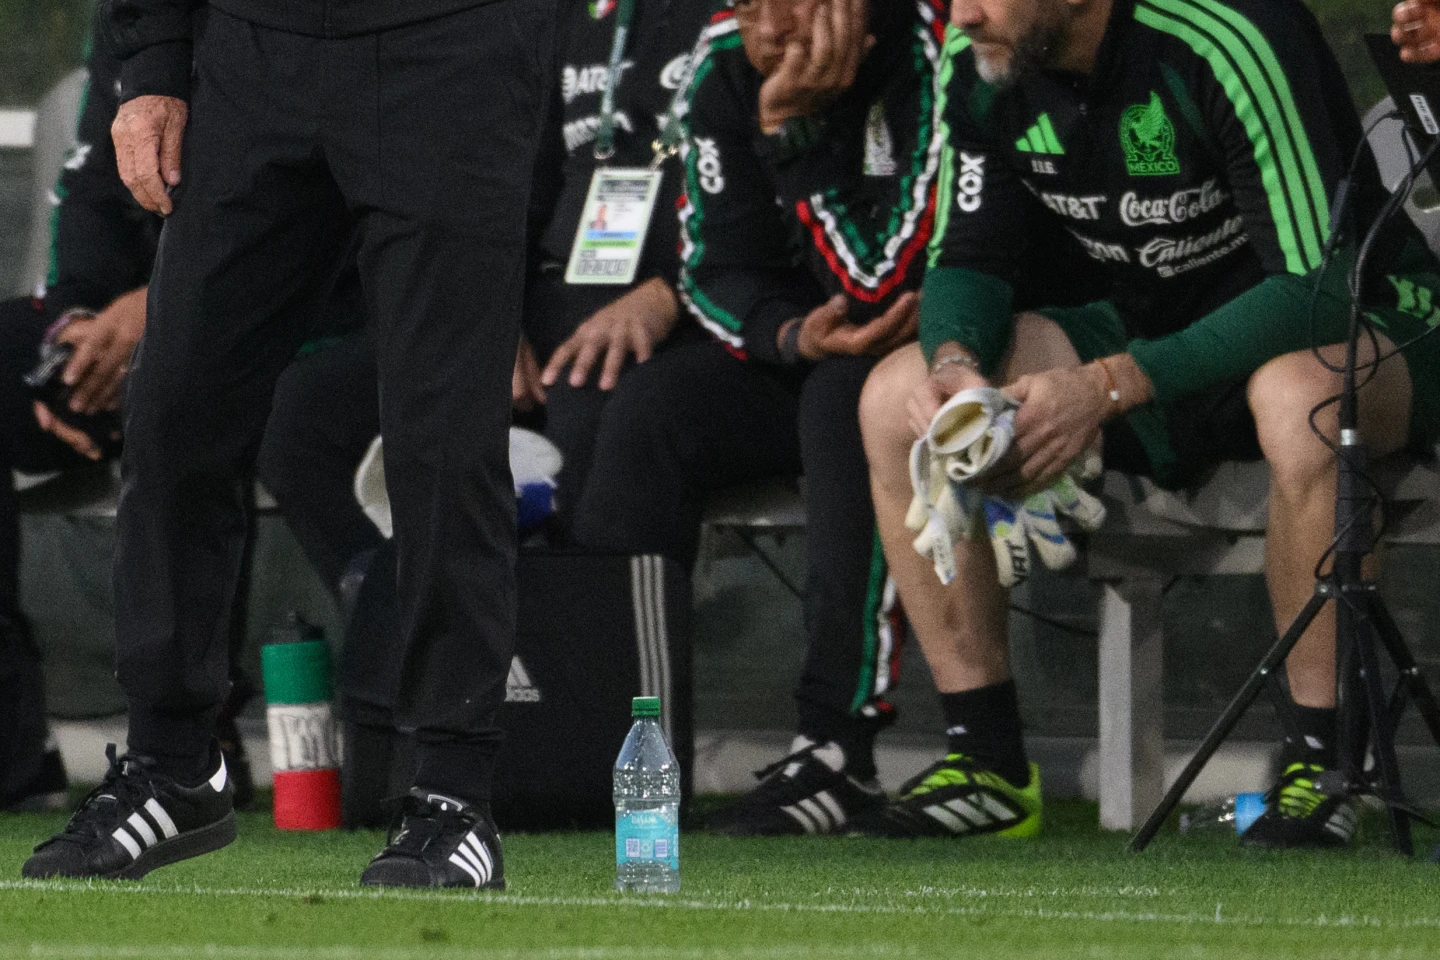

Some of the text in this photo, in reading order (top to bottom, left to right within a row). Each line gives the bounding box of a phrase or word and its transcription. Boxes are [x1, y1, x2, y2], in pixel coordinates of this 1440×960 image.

[695, 136, 725, 194] COX
[957, 151, 985, 213] COX
[1119, 178, 1229, 227] Coca-Cola
[505, 688, 540, 702] didas
